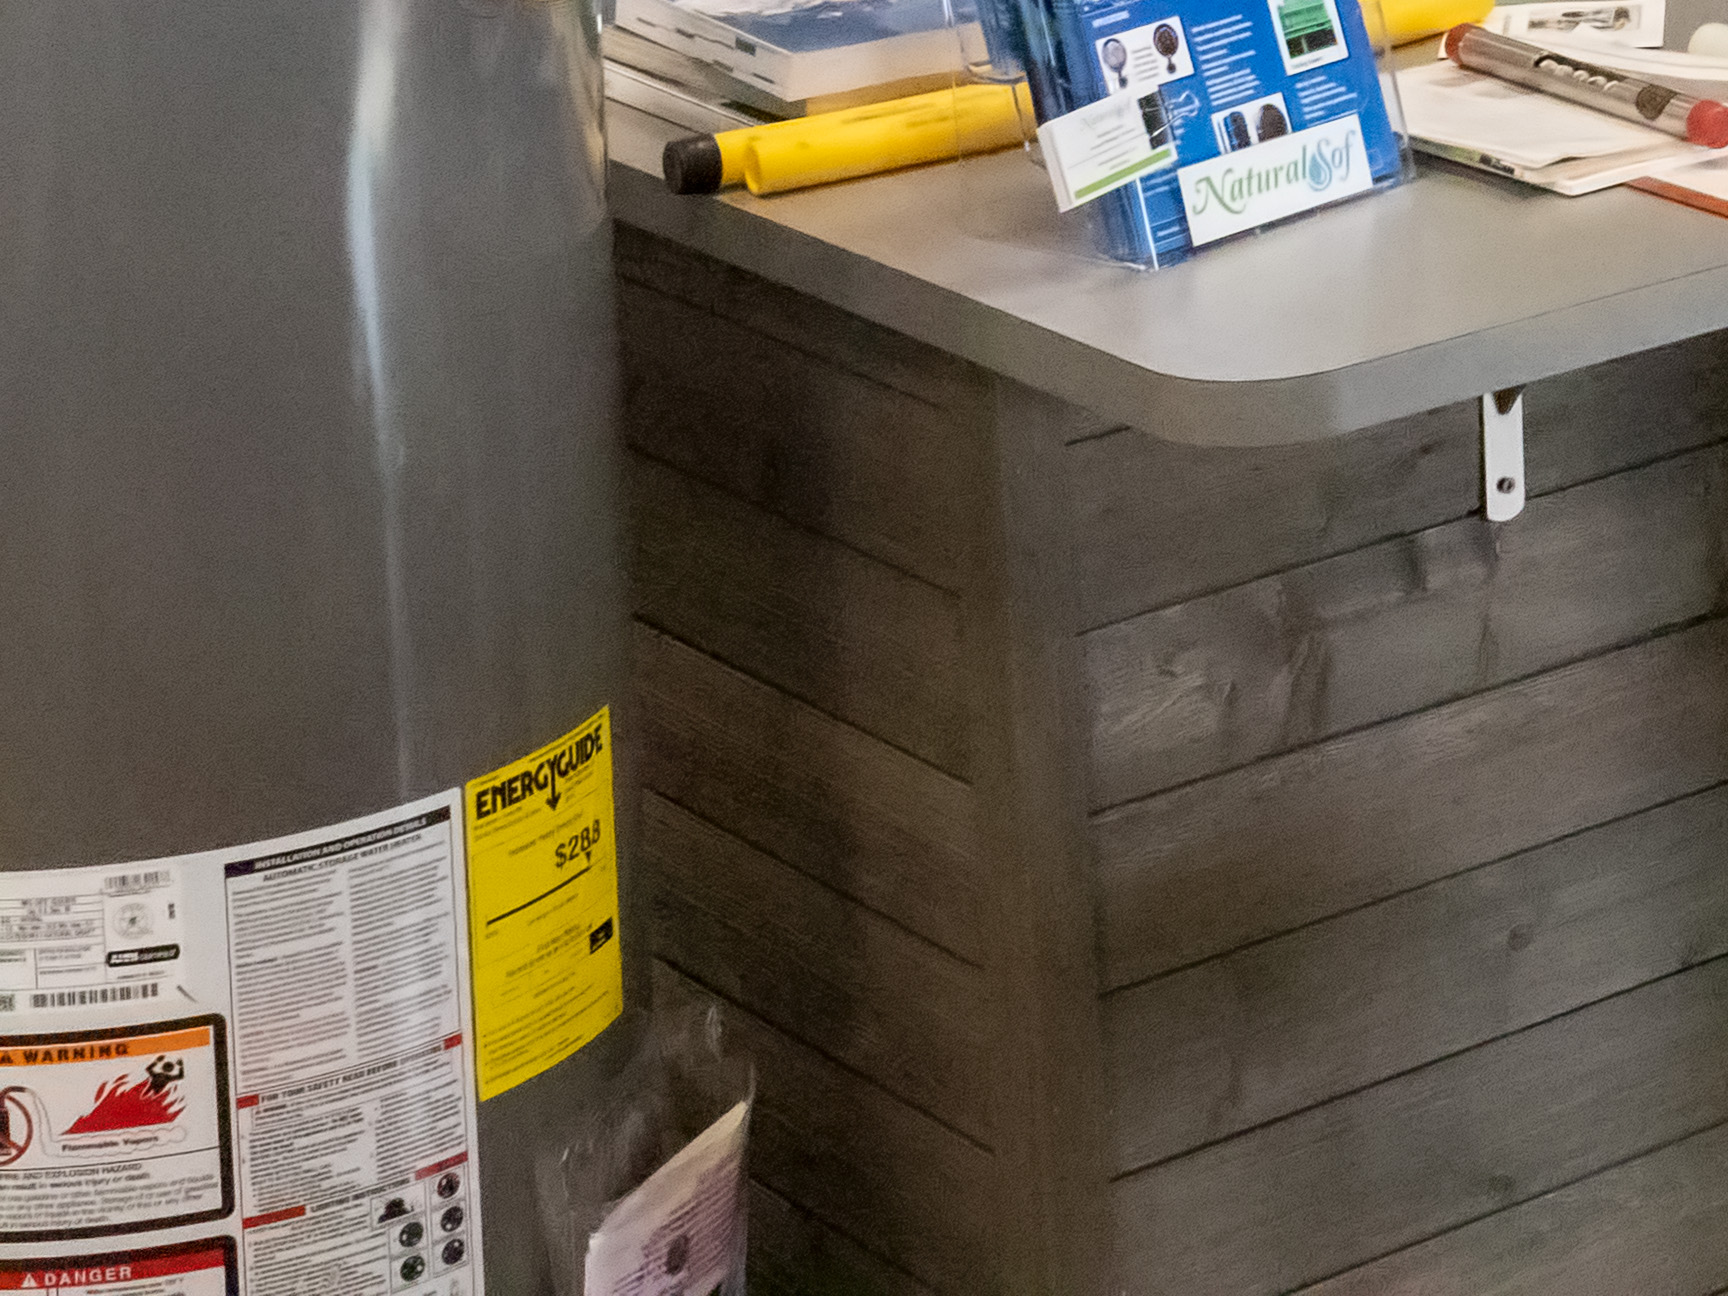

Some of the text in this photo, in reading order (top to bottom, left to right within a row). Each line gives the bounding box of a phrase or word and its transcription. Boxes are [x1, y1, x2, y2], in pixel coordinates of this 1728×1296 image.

[1192, 130, 1357, 216] NaturalSof
[476, 723, 604, 821] ENERGYGUIDE
[254, 849, 322, 871] INSTALLATION
[22, 1042, 131, 1064] WARNING
[61, 1134, 159, 1153] Flammable Vapors
[22, 1170, 44, 1180] AND
[45, 1166, 100, 1179] EXPLOSION
[102, 1162, 143, 1175] HAZARD
[85, 1176, 111, 1188] injury
[44, 1265, 133, 1288] DANGER
